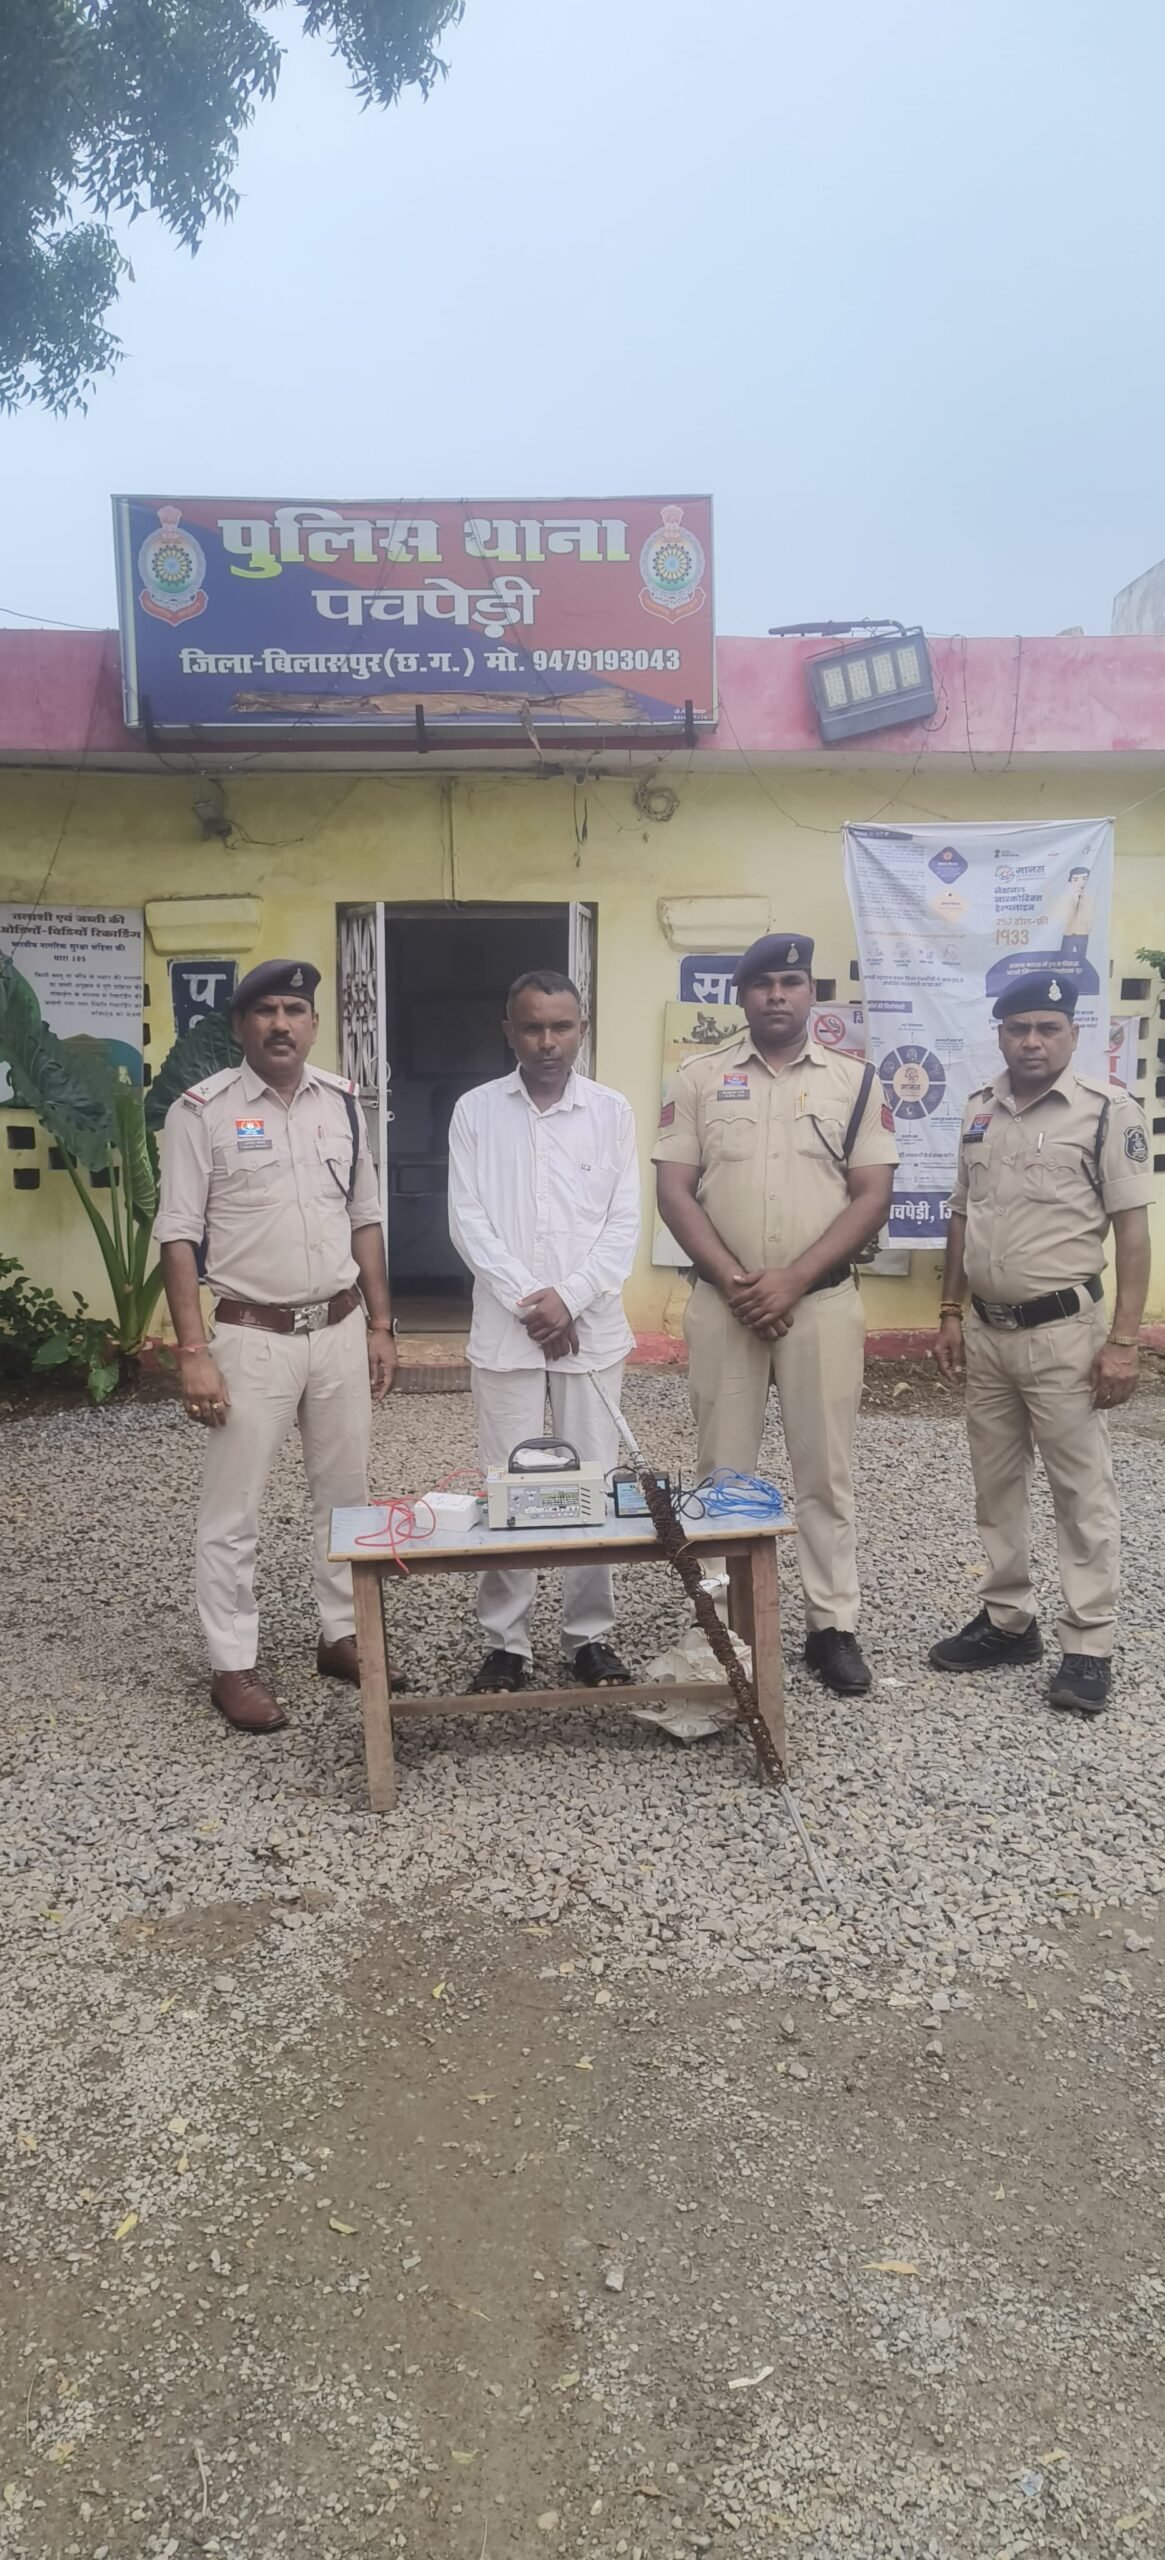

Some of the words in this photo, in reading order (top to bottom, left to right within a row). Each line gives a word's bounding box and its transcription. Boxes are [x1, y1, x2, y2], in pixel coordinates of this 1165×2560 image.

[217, 507, 442, 579] पुलिस
[463, 517, 630, 563] थाना
[311, 576, 540, 638] पचपेड़ी
[485, 646, 525, 673] मो.
[533, 648, 681, 673] 9479193043
[12, 912, 53, 922] तलाशी
[109, 914, 125, 924] की
[995, 928, 1030, 946] 1933
